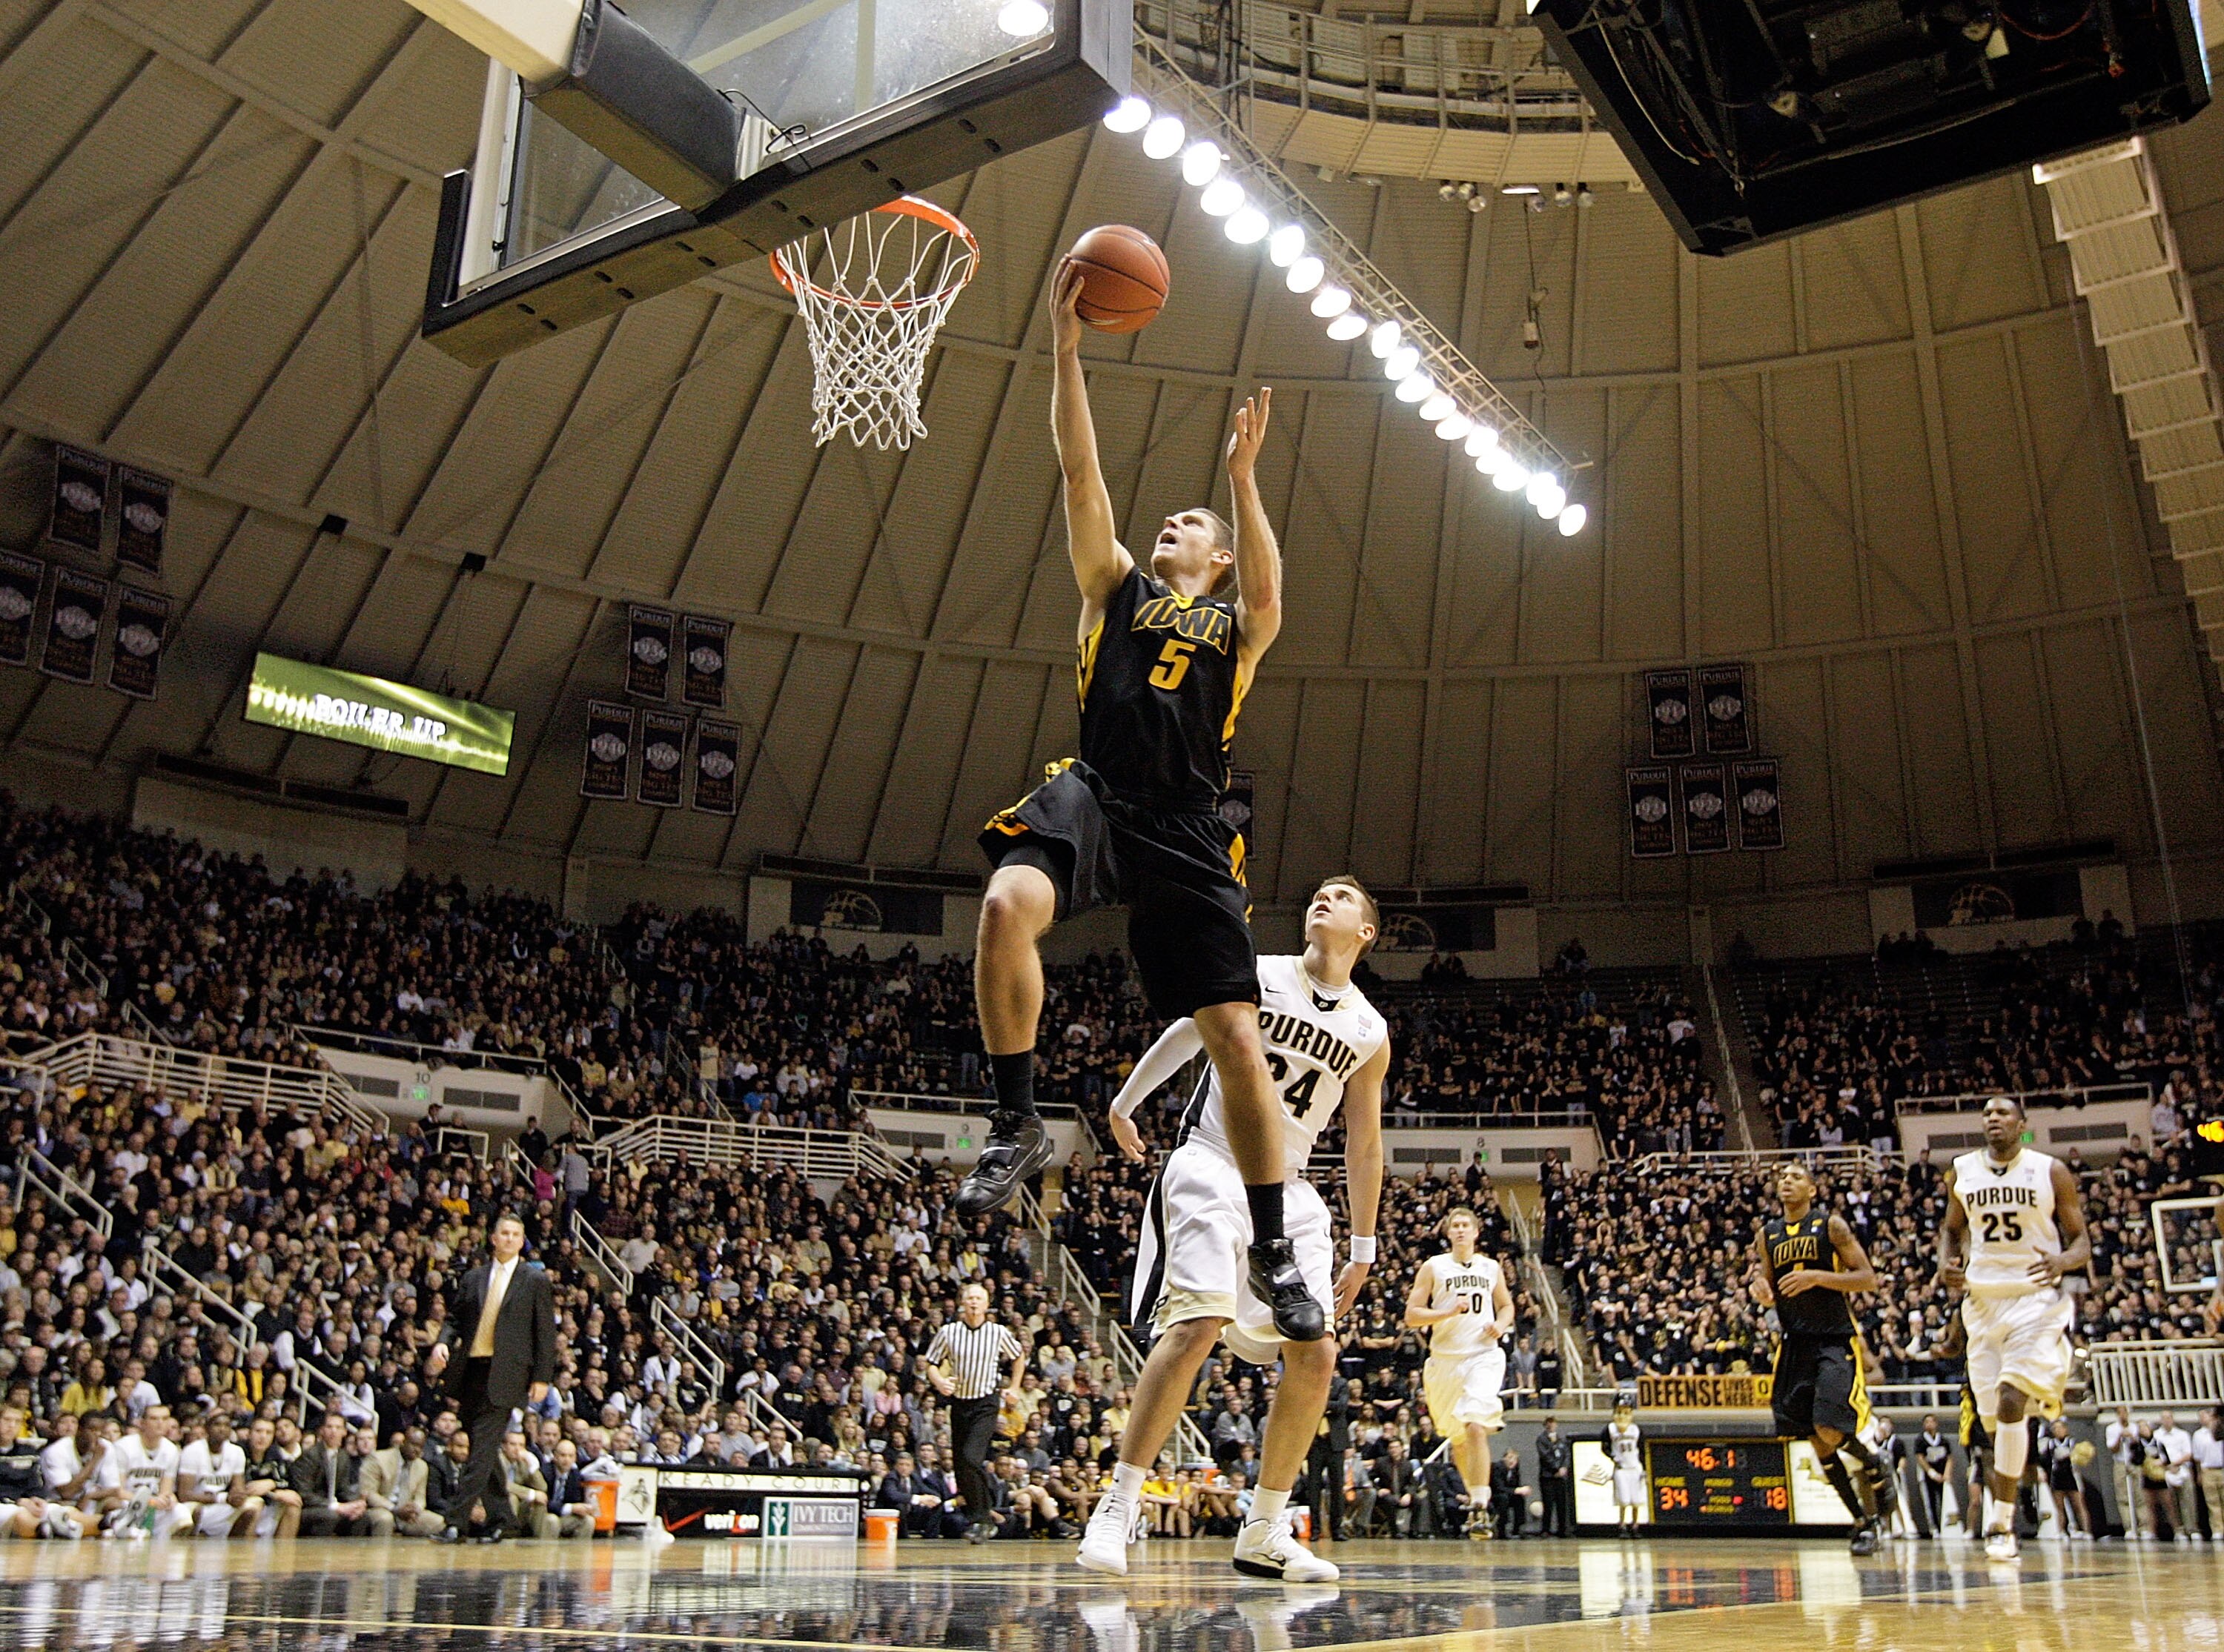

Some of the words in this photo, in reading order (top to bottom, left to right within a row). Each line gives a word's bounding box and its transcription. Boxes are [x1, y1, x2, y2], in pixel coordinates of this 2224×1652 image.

[1131, 596, 1231, 655] IOWA
[1148, 638, 1197, 690] 5
[314, 694, 404, 737] BOILER
[412, 716, 446, 741] UP
[1259, 1011, 1358, 1080] PURDUE
[417, 1072, 431, 1084] 10
[1966, 1187, 2037, 1209] PURDUE
[1982, 1211, 2022, 1241] 25
[1773, 1235, 1818, 1269] IOWA
[1446, 1275, 1490, 1292] PURDUE
[1639, 1379, 1722, 1407] DEFENSE
[1725, 1392, 1753, 1406] HERE
[662, 1472, 754, 1487] KEADY
[772, 1476, 858, 1491] COURT
[1660, 1487, 1689, 1510] 34
[1766, 1486, 1787, 1510] 18
[705, 1510, 759, 1532] verizon
[795, 1505, 818, 1523] IVY
[821, 1505, 853, 1524] TECH
